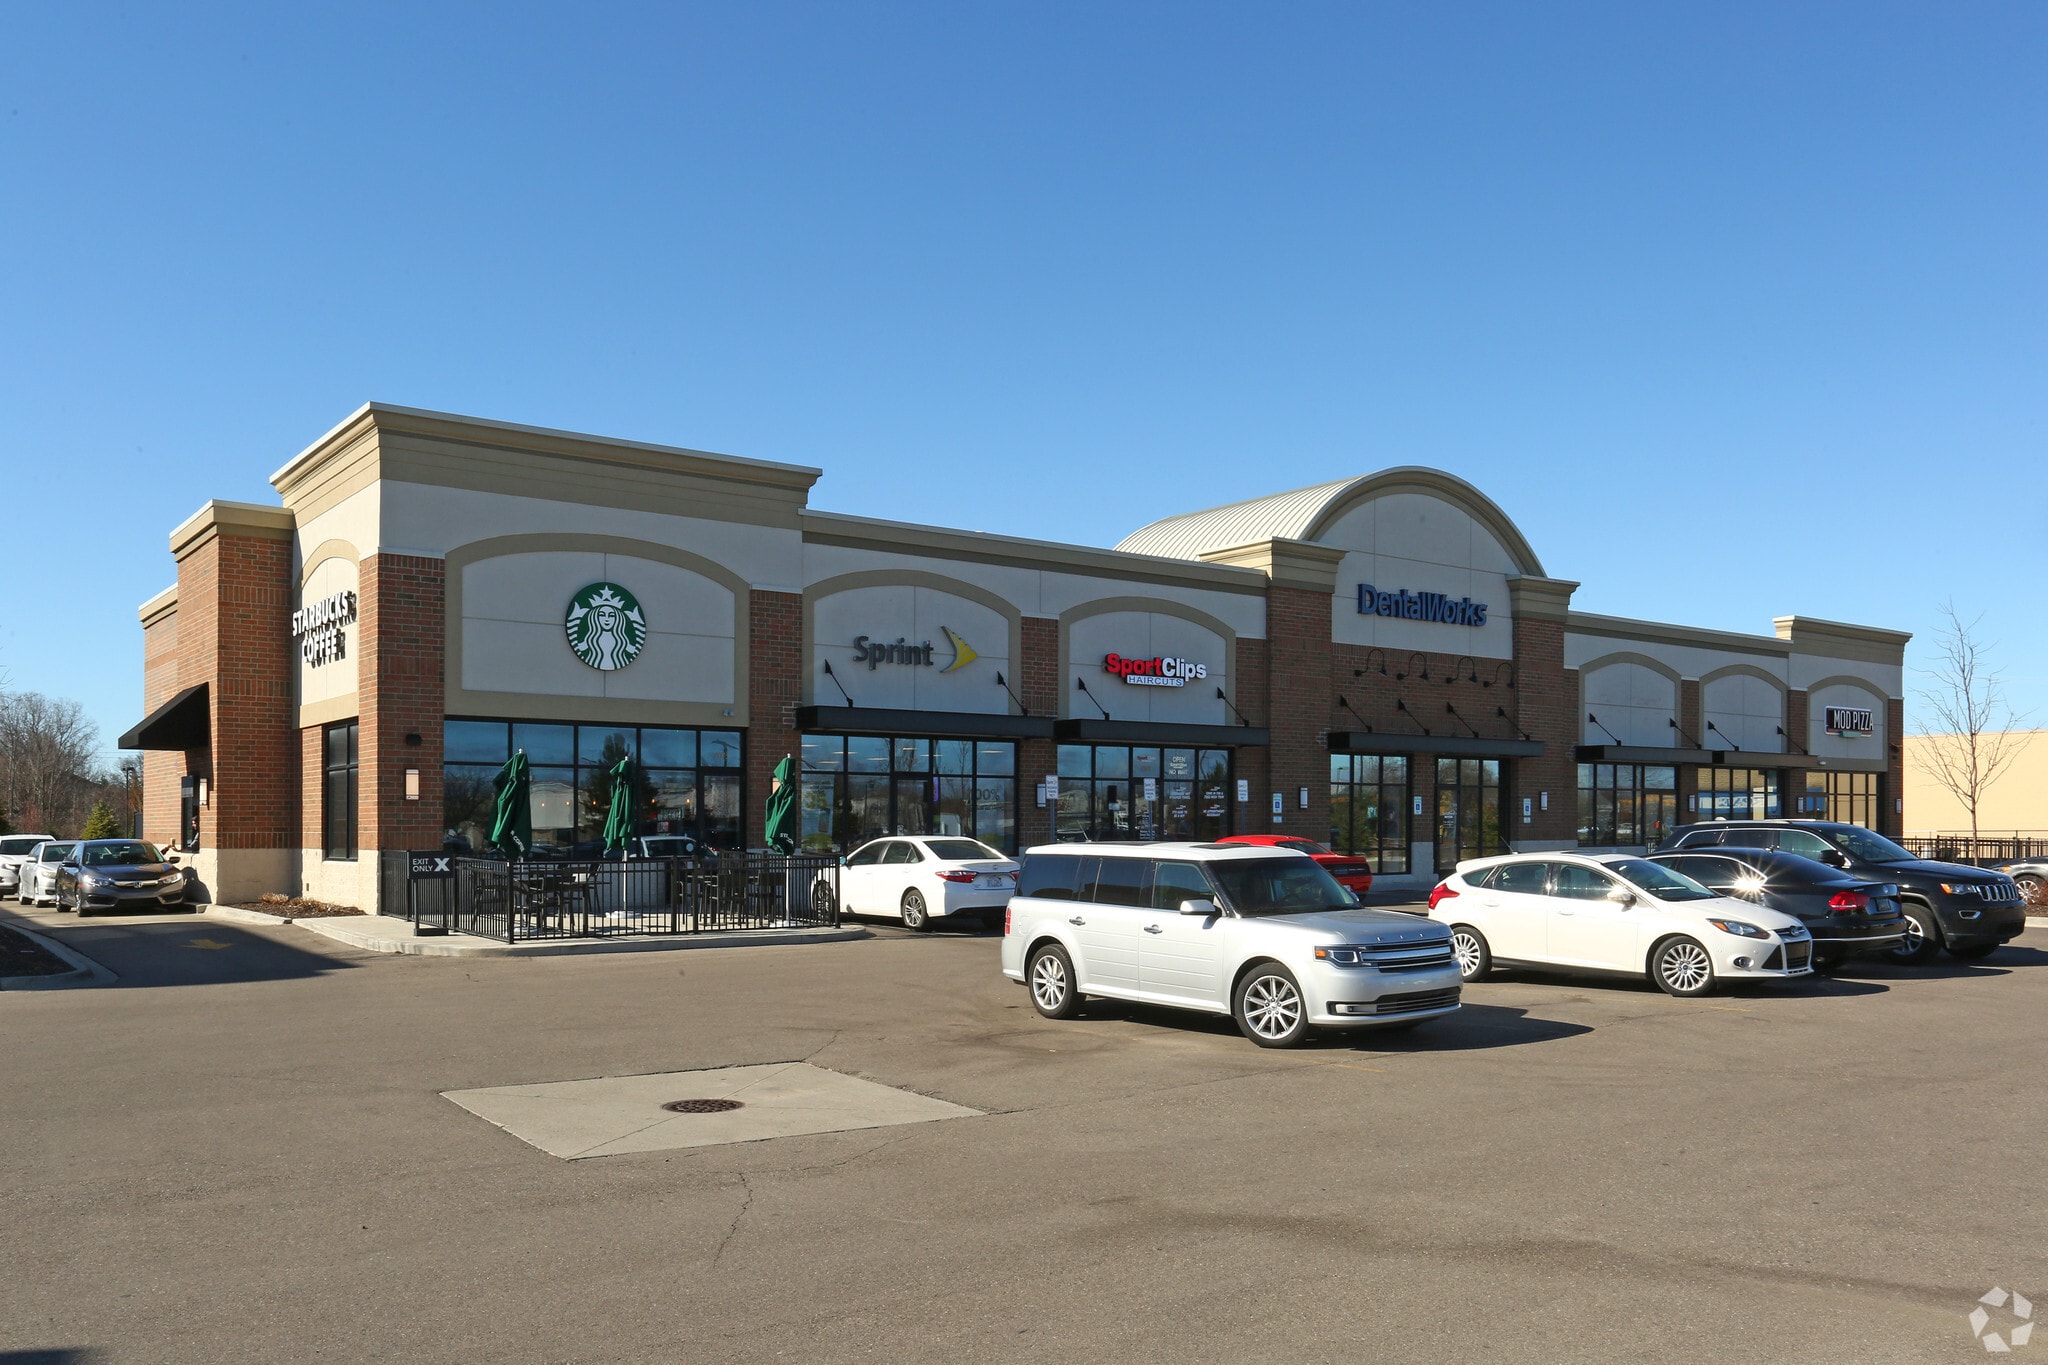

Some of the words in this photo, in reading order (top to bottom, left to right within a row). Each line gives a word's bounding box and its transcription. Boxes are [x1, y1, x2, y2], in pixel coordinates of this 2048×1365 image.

[292, 590, 350, 637] STARBUCKS
[1357, 583, 1488, 627] DentalWorks
[301, 628, 338, 663] COFFEE
[852, 635, 934, 671] Sprint
[1106, 653, 1207, 681] SportClips
[1128, 676, 1183, 687] HAIRCUTS
[1833, 709, 1851, 729] MOD
[1852, 711, 1874, 731] PIZZA
